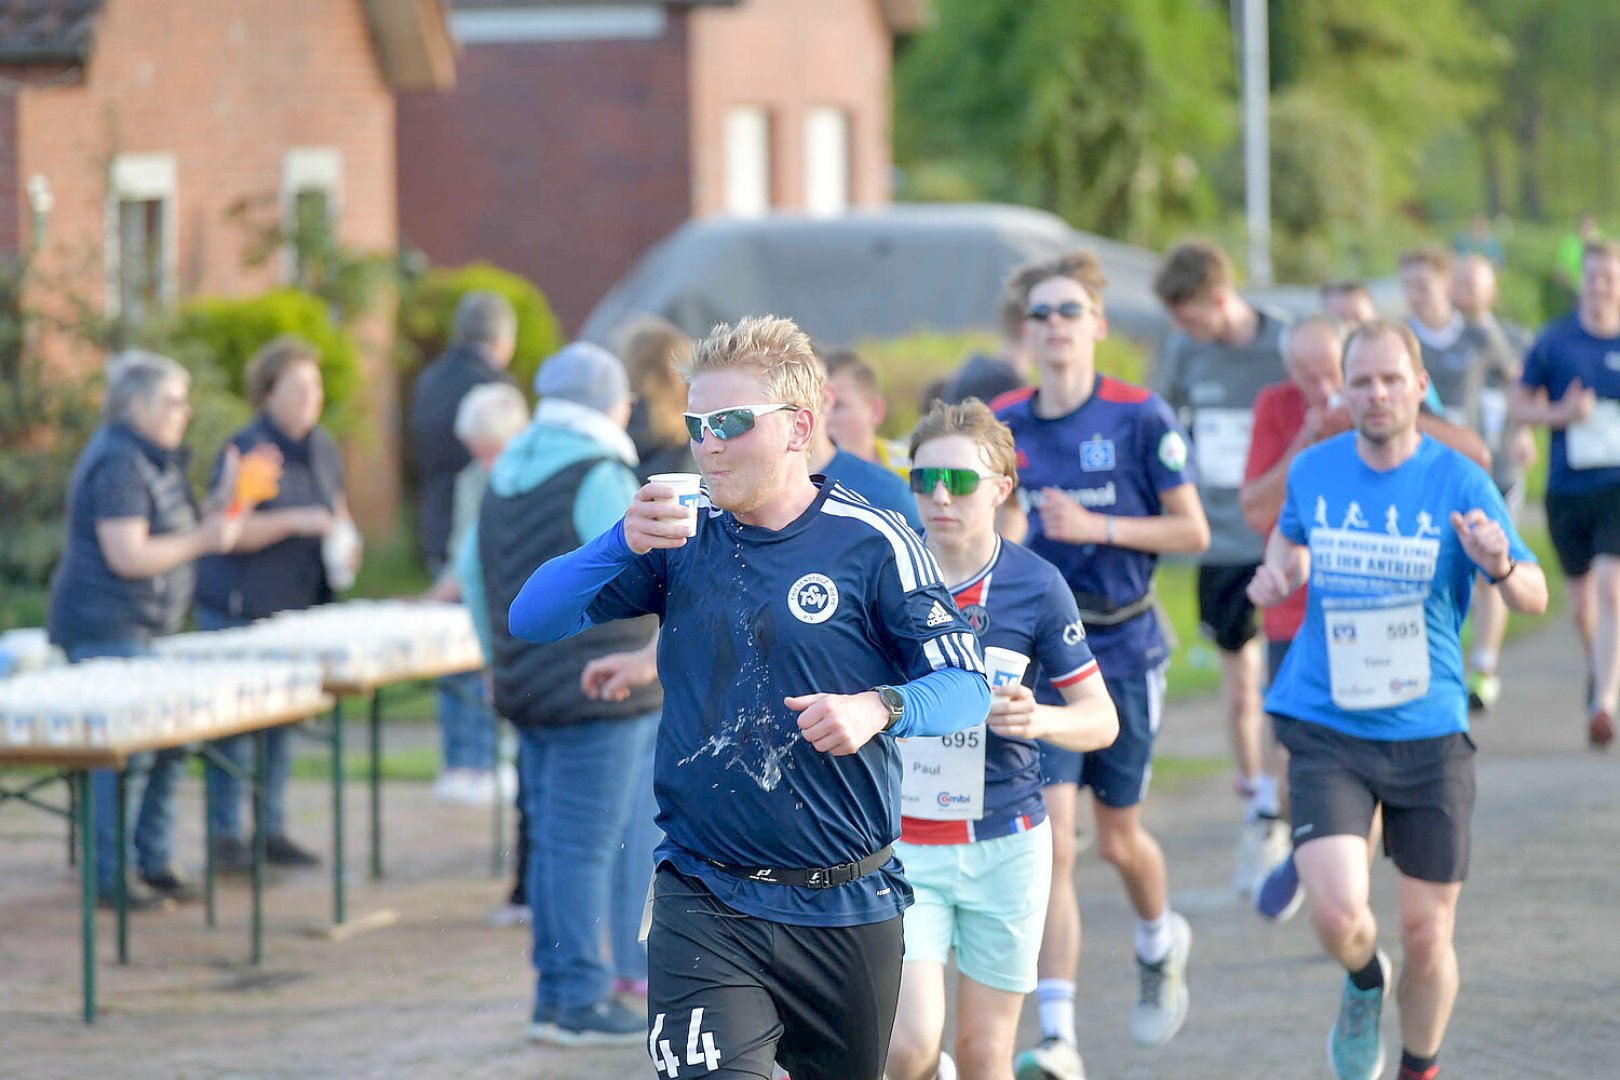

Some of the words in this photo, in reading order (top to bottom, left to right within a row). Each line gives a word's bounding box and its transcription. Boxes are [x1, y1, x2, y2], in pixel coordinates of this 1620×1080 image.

[800, 585, 828, 609] TSV
[927, 614, 953, 627] adidas
[942, 731, 979, 748] 695
[913, 762, 941, 775] Paul
[649, 1007, 721, 1079] 44
